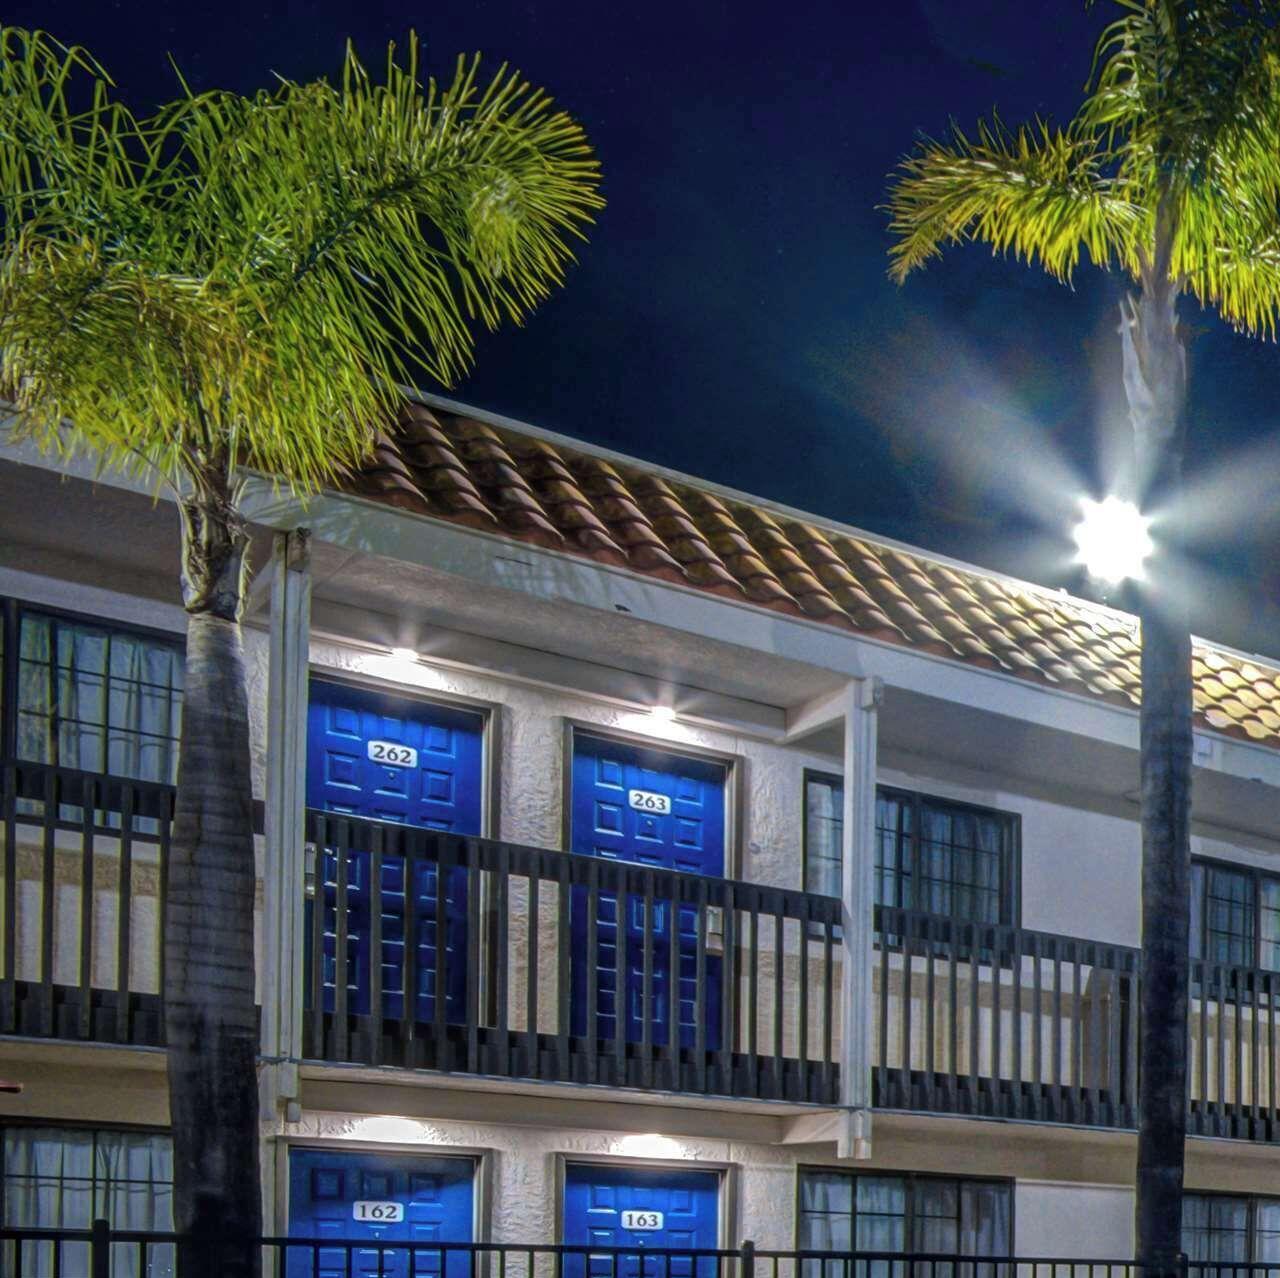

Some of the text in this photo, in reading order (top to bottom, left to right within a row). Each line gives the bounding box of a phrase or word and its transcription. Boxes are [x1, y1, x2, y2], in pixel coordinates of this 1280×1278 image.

[372, 744, 412, 764] 262
[633, 792, 666, 811] 263
[359, 1204, 398, 1219] 162
[627, 1213, 659, 1228] 163
